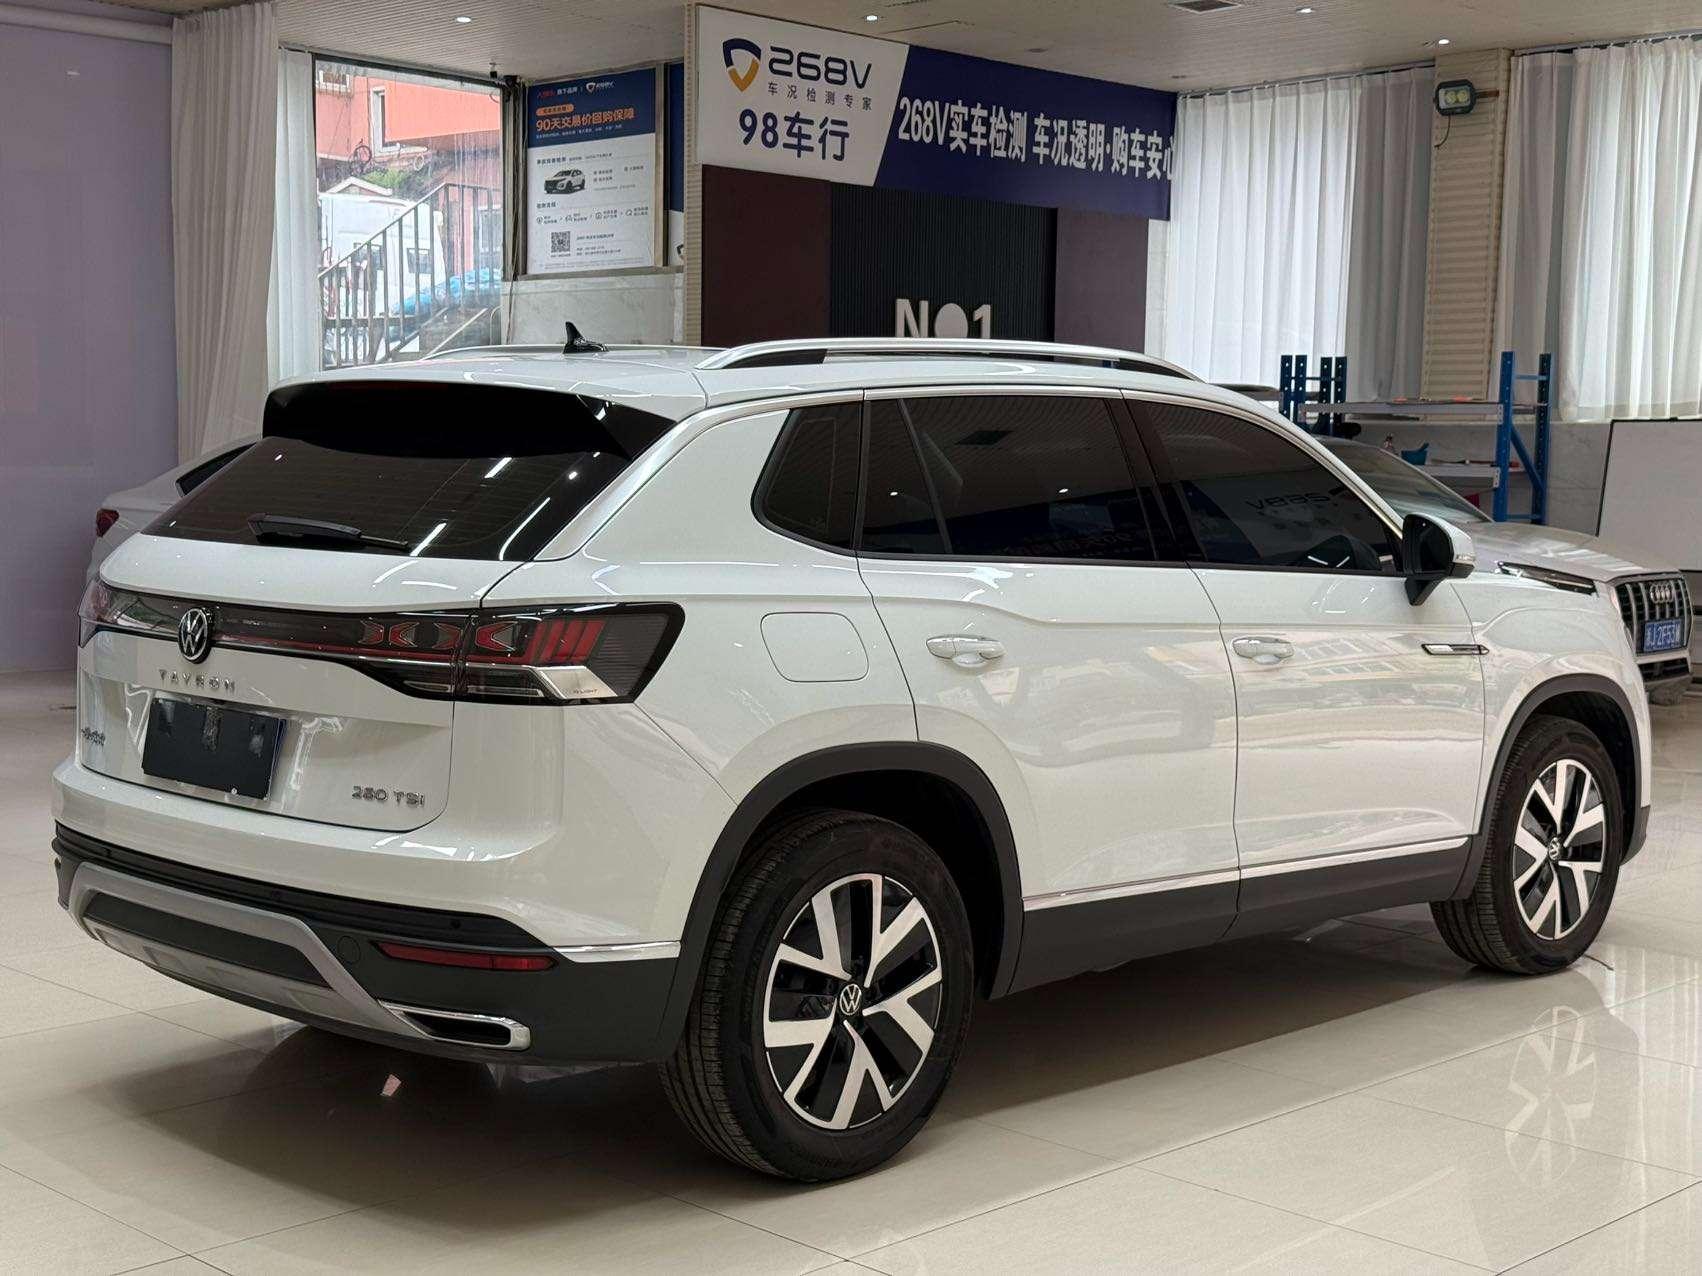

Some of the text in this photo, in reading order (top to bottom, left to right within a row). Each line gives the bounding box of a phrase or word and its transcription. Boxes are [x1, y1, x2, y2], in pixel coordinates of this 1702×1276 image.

[768, 45, 873, 90] 268V
[767, 80, 873, 112] 车况检测专家
[739, 108, 850, 162] 98车行
[899, 97, 1027, 163] 268V实车检测
[158, 668, 236, 693] TAYRON
